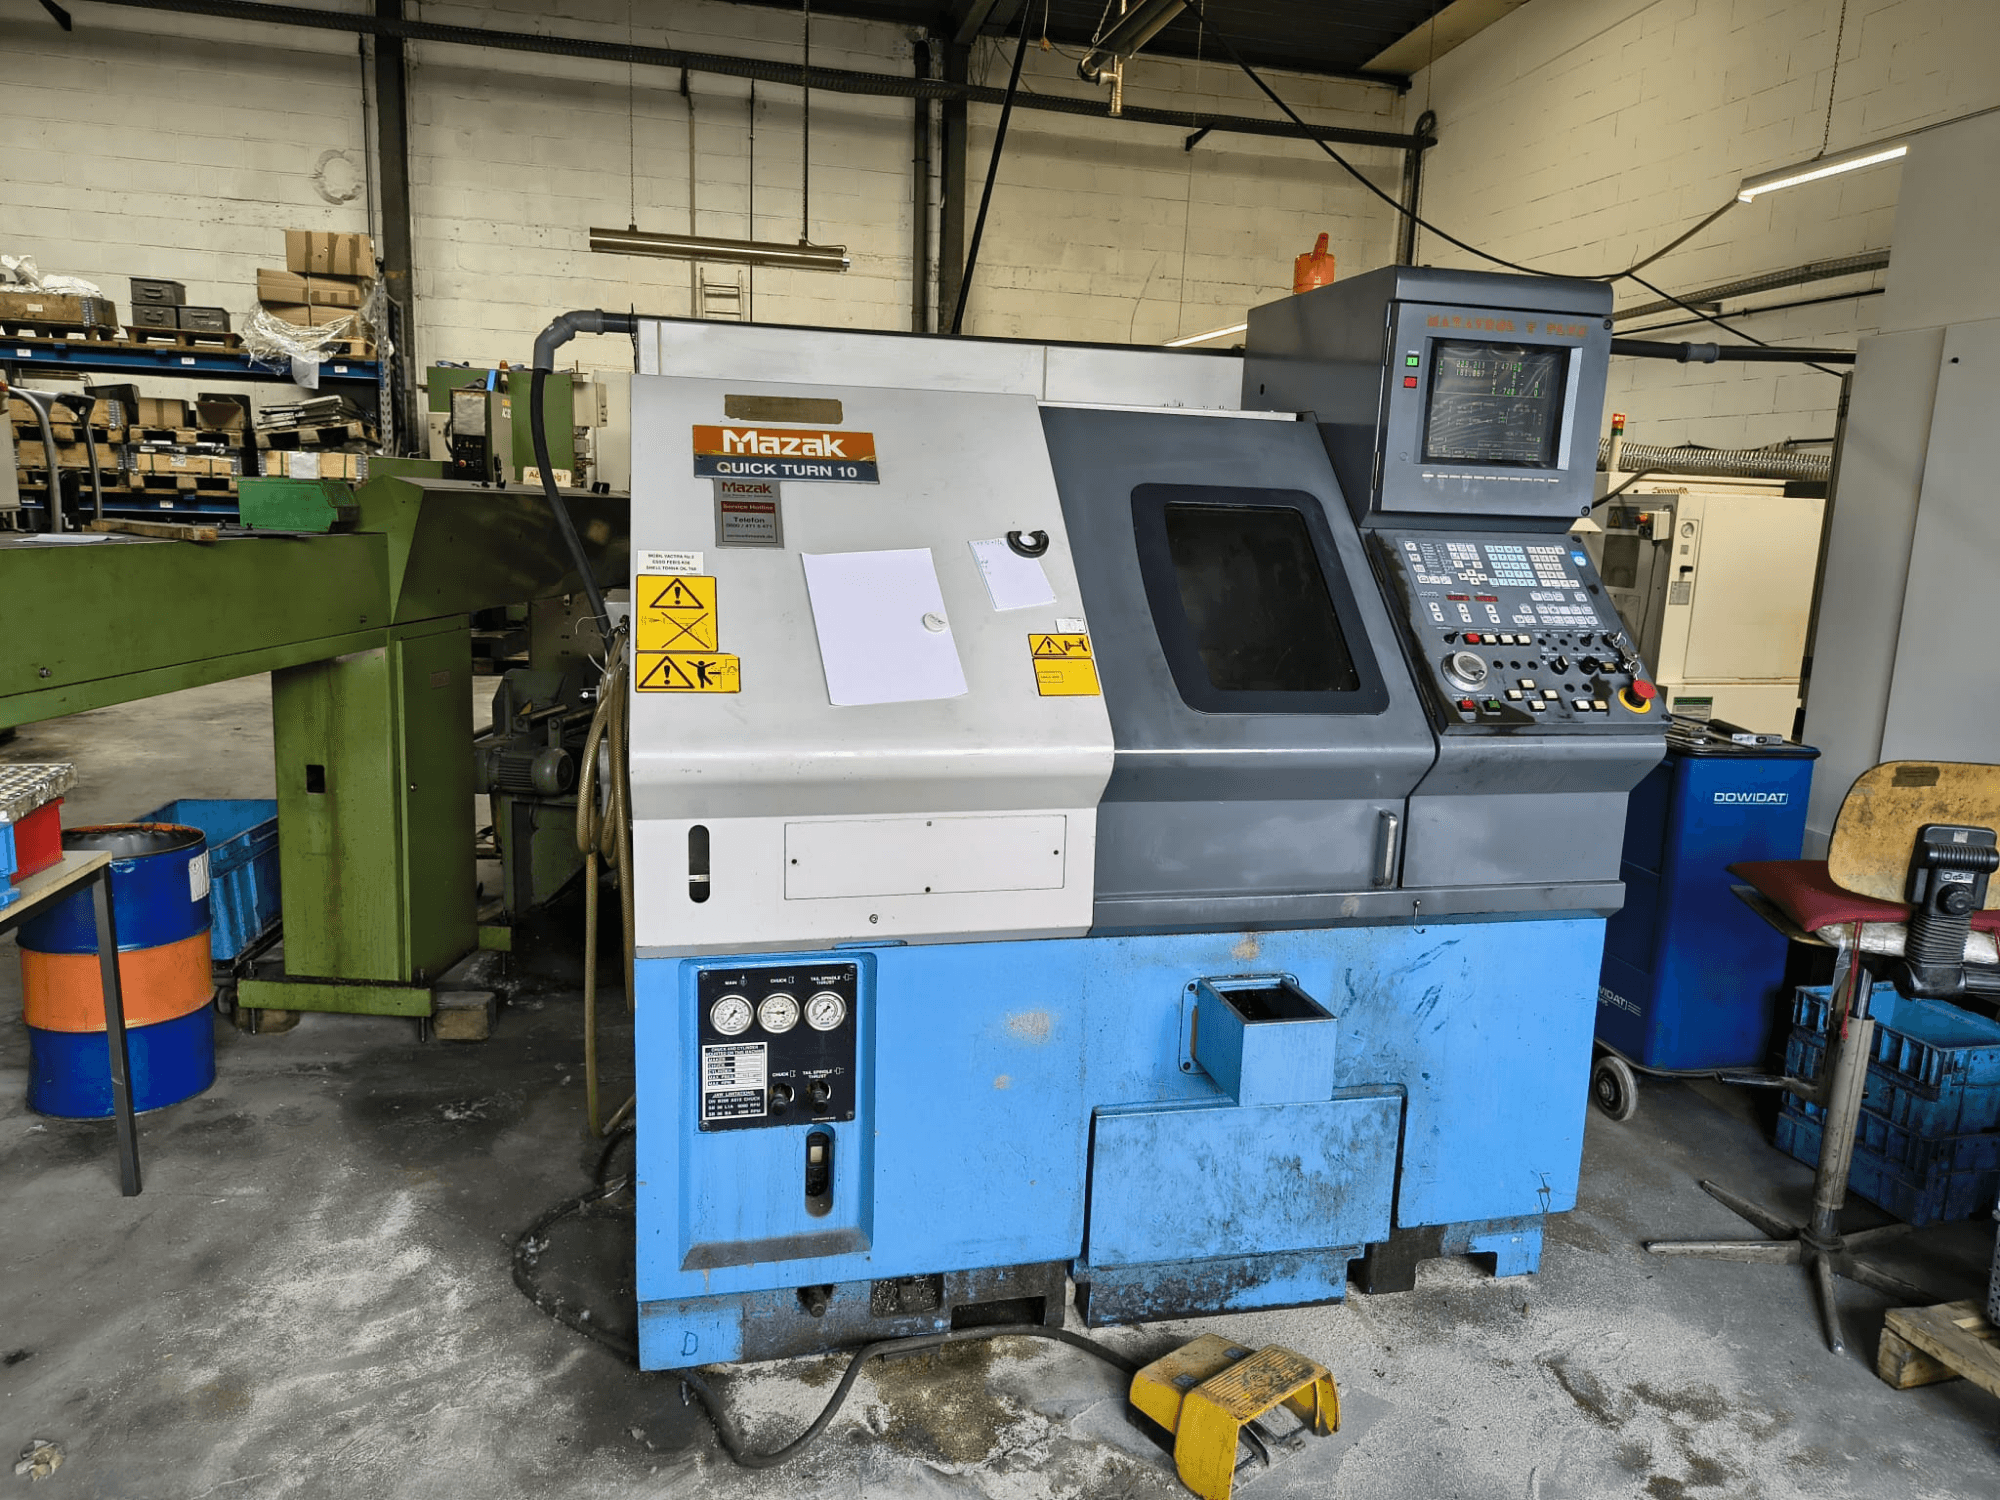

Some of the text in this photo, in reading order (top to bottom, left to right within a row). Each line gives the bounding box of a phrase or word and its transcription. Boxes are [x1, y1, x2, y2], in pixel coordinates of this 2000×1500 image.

[722, 429, 848, 458] Mazak
[716, 461, 858, 478] QUICK TURN 10
[722, 482, 773, 494] Mazak
[1714, 792, 1788, 804] DOWIDAT
[681, 1330, 698, 1356] D
